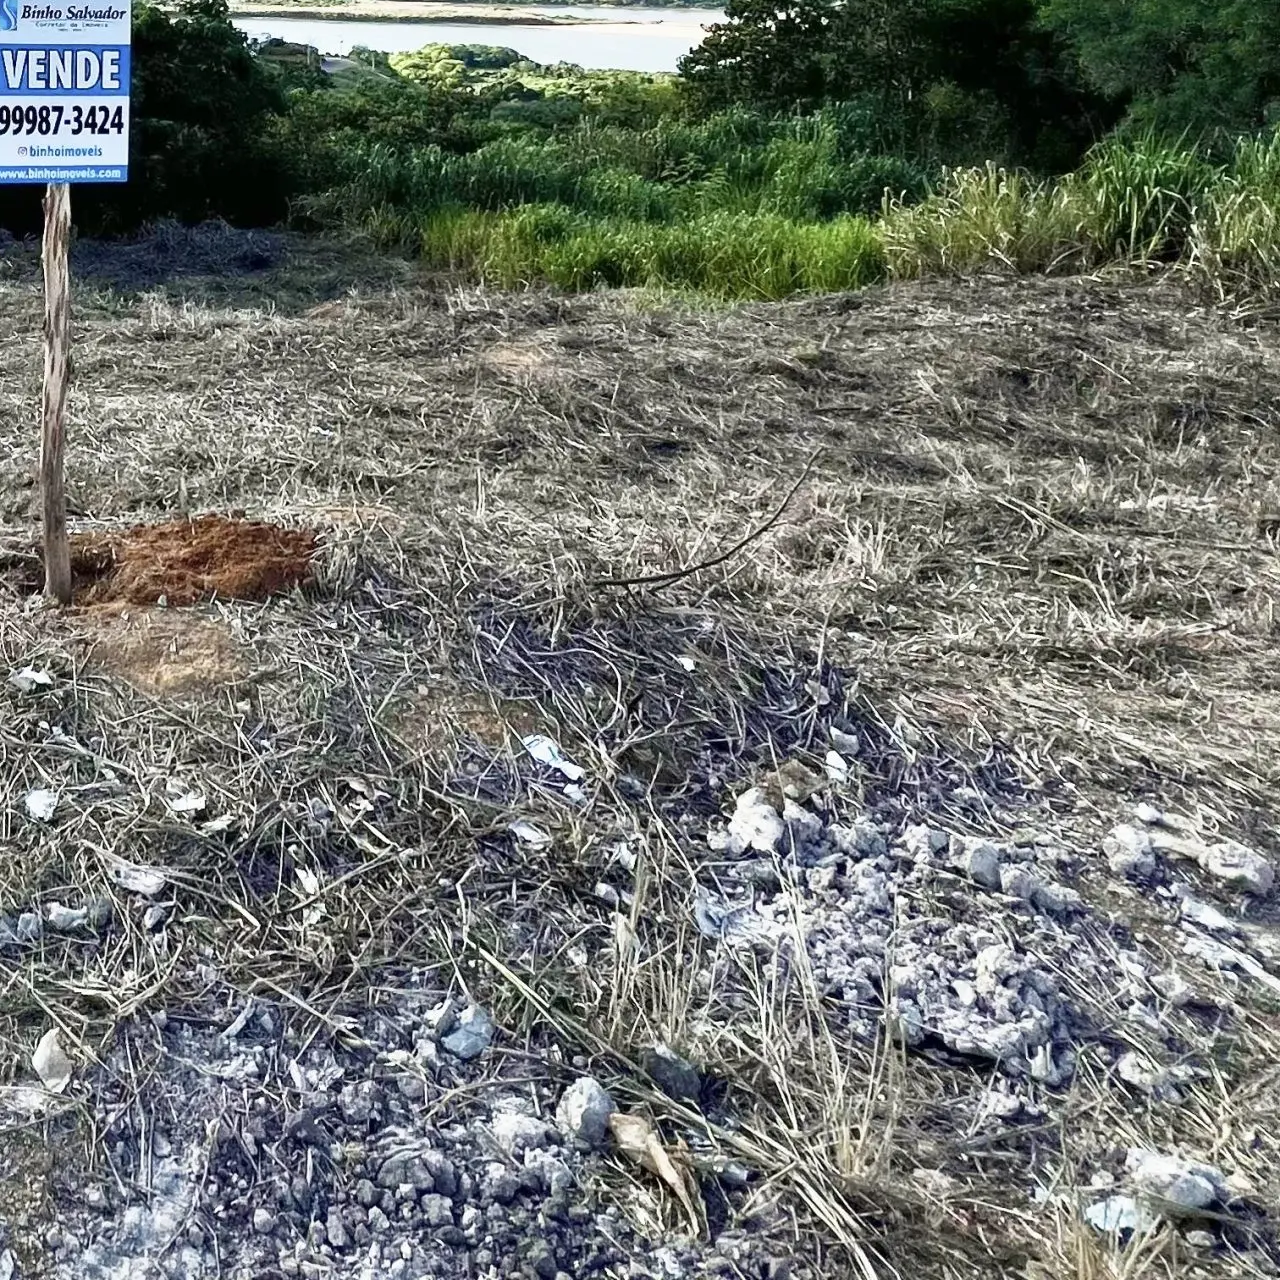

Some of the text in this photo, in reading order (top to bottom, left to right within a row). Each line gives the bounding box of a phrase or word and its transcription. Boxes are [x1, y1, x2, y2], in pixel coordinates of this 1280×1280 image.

[21, 4, 127, 20] Binho Salvador
[1, 50, 120, 89] VENDE
[29, 145, 102, 157] binhoimoveis
[0, 168, 121, 180] www.binhoimoveis.com
